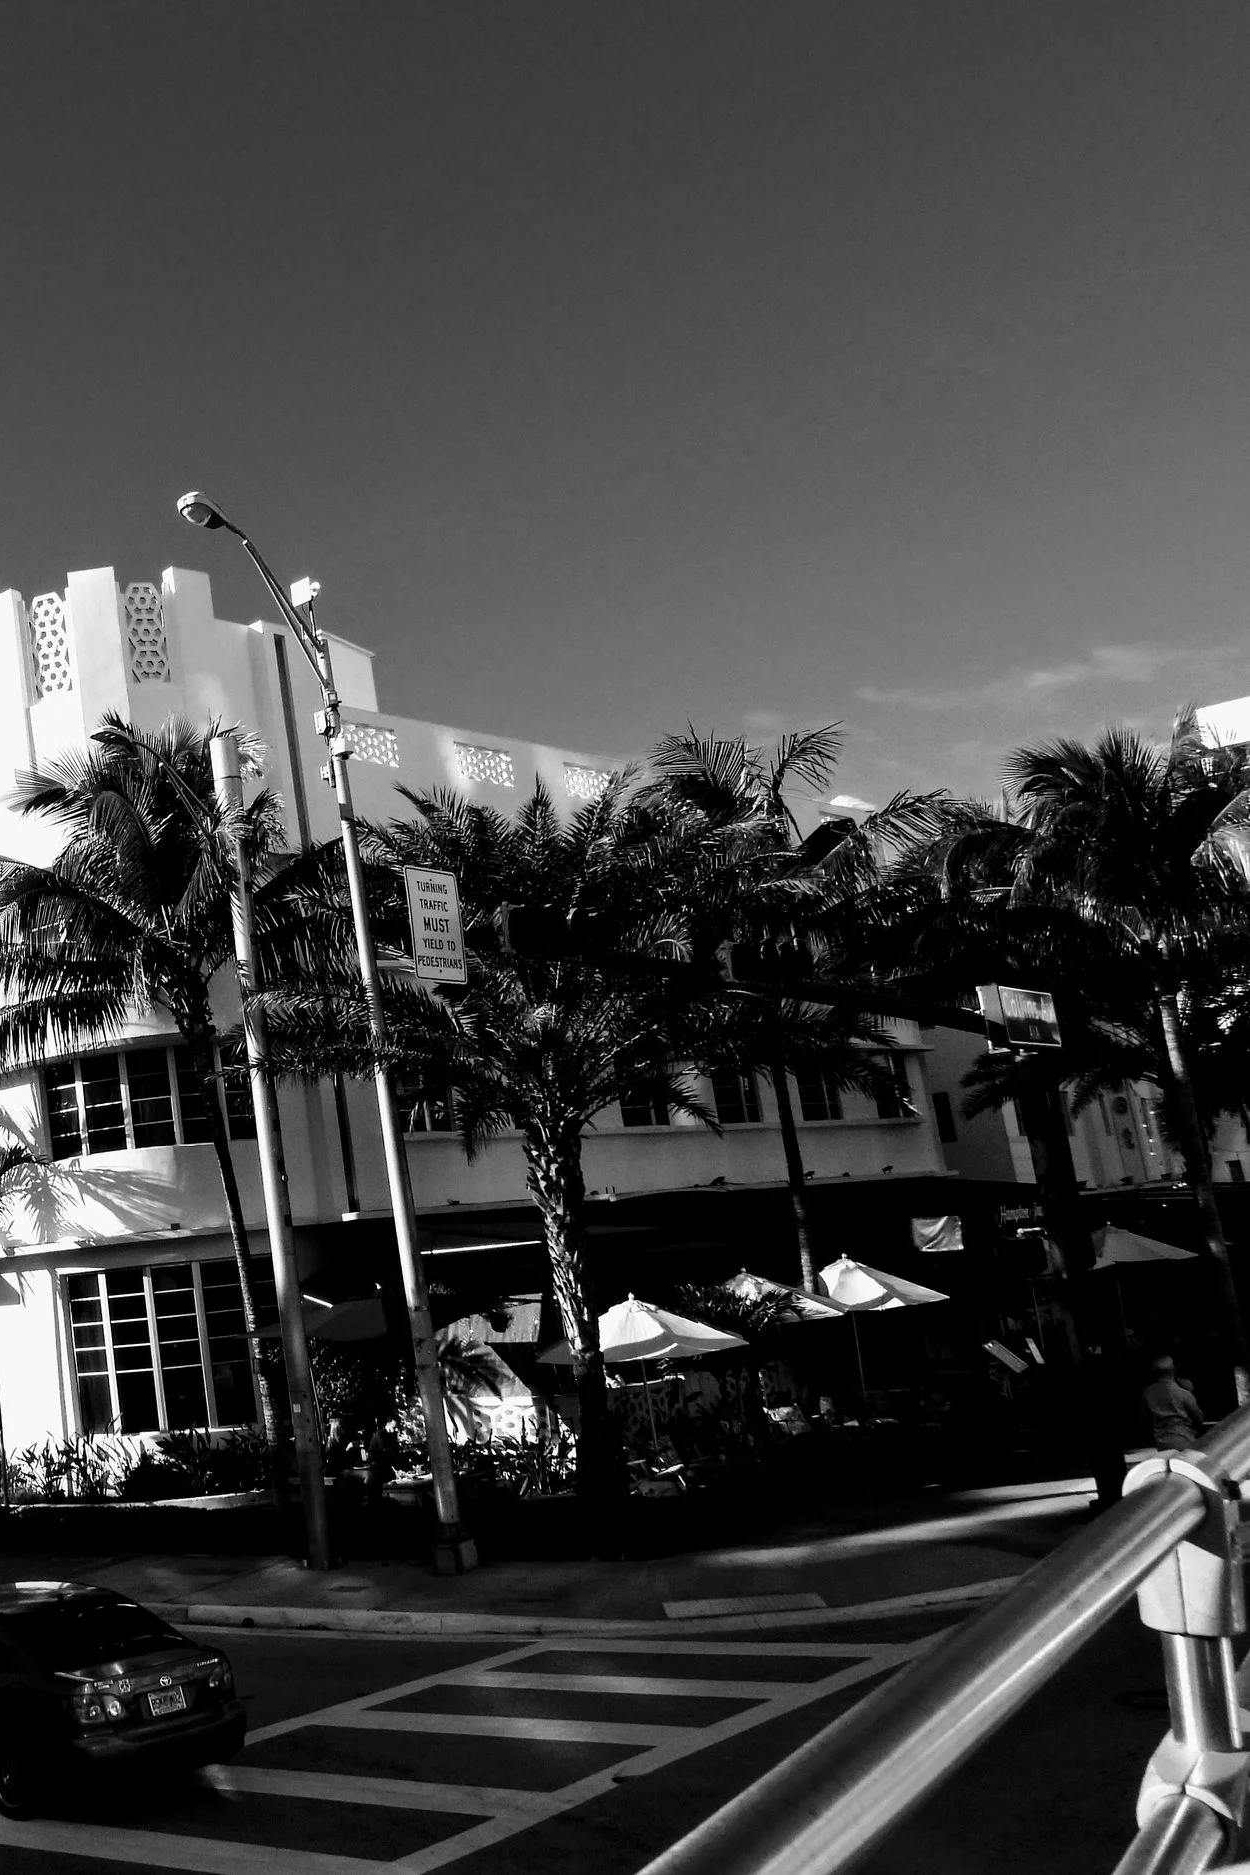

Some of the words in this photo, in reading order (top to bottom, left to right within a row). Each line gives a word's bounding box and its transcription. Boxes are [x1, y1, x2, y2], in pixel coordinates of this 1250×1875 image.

[416, 880, 448, 895] TURNING
[419, 898, 449, 912] TRAFFIC
[423, 917, 450, 933] MUST
[422, 938, 444, 950] YIELD
[447, 940, 456, 951] TO
[417, 955, 463, 970] PEDESTRIANS
